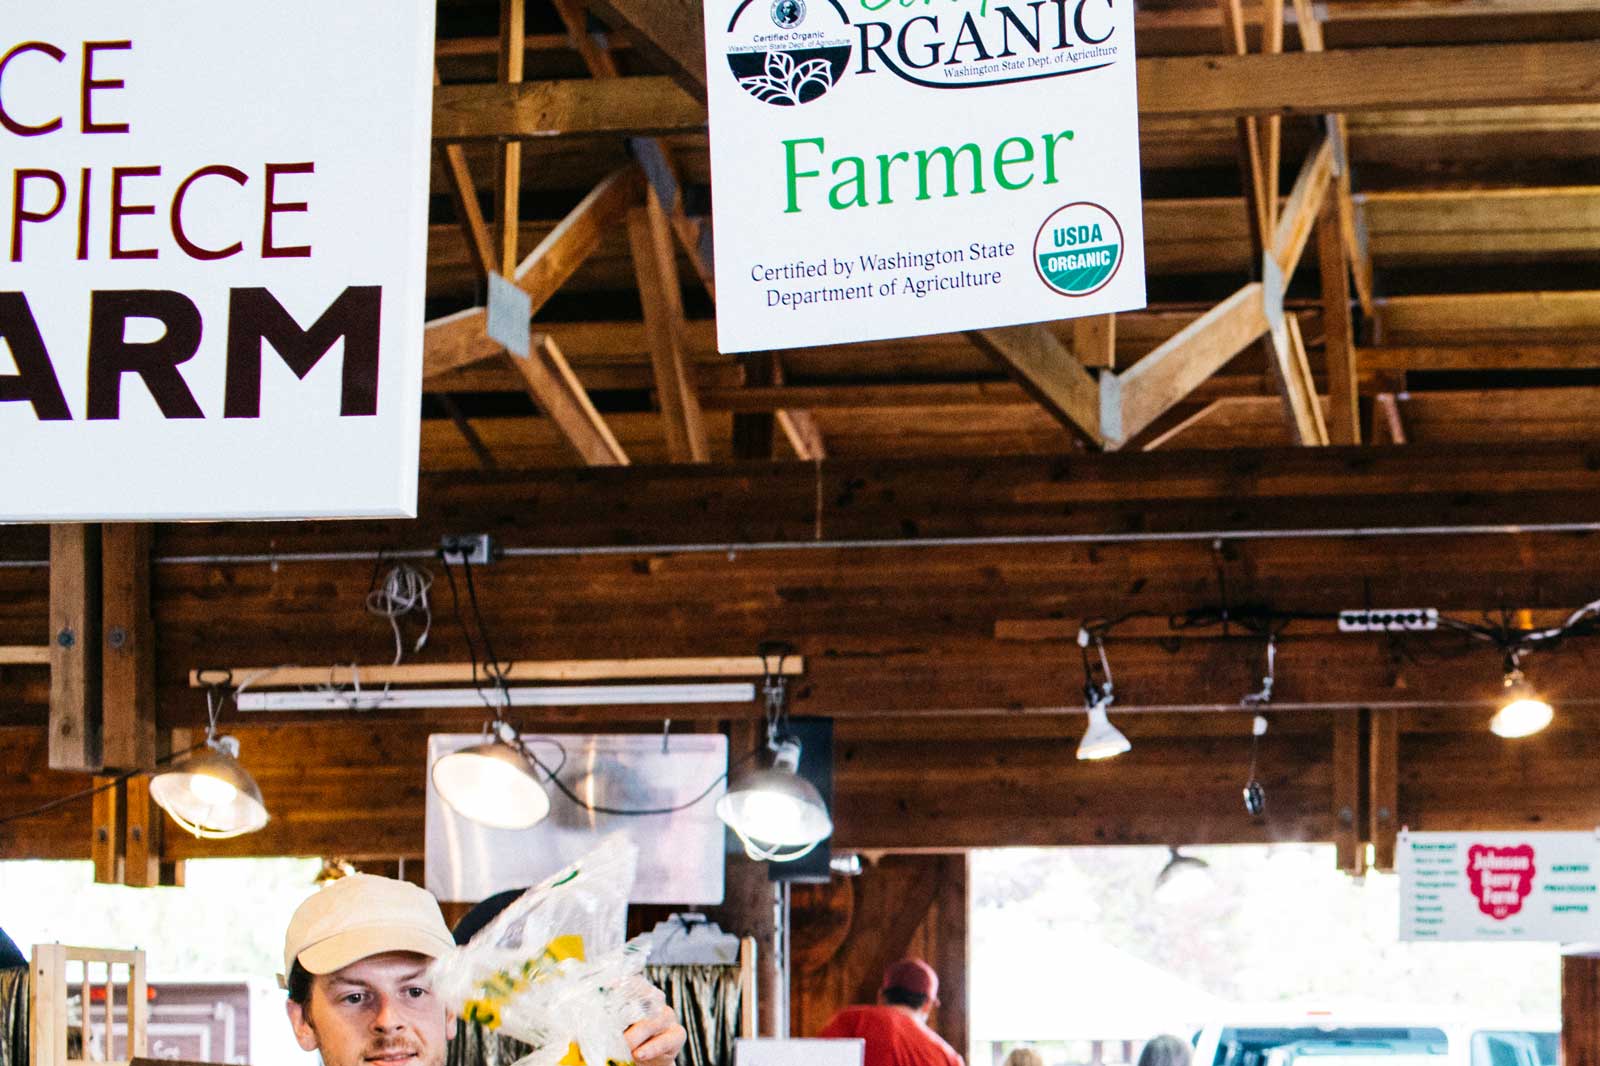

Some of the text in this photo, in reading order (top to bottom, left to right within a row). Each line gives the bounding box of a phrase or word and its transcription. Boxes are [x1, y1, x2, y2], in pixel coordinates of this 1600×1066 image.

[752, 31, 825, 43] Certified Organic
[944, 46, 1118, 78] Washington State Dept. of Agriculture
[0, 40, 132, 136] CE
[781, 129, 1075, 214] Farmer
[9, 161, 315, 262] PIECE
[1053, 223, 1103, 248] USDA
[751, 241, 1016, 282] Certified by Washington State
[1048, 250, 1112, 274] ORGANIC
[766, 270, 1002, 311] Department of Agriculture
[0, 286, 382, 421] ARM
